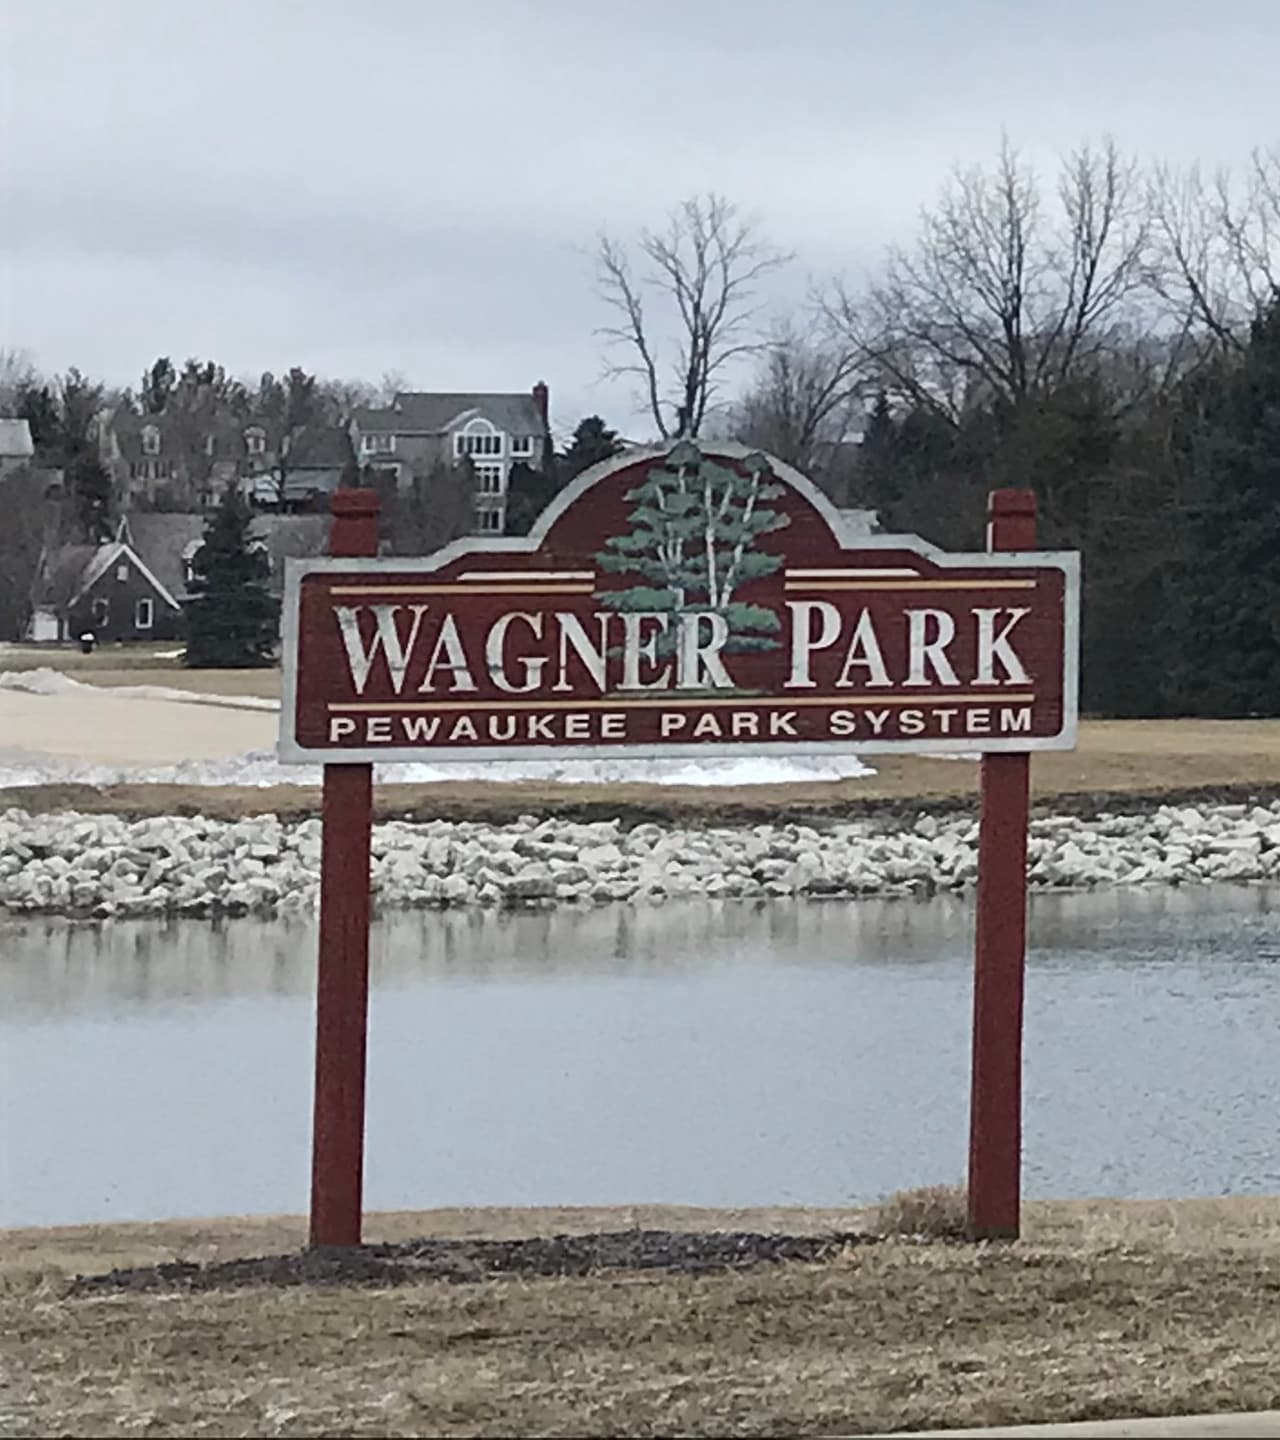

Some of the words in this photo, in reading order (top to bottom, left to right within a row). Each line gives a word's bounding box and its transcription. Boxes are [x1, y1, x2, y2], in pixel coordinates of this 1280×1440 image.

[332, 604, 735, 696] WAGNER
[784, 600, 1033, 691] PARK
[330, 712, 627, 743] PEWAUKEE
[661, 711, 799, 738] PARK
[830, 708, 1033, 735] SYSTEM
